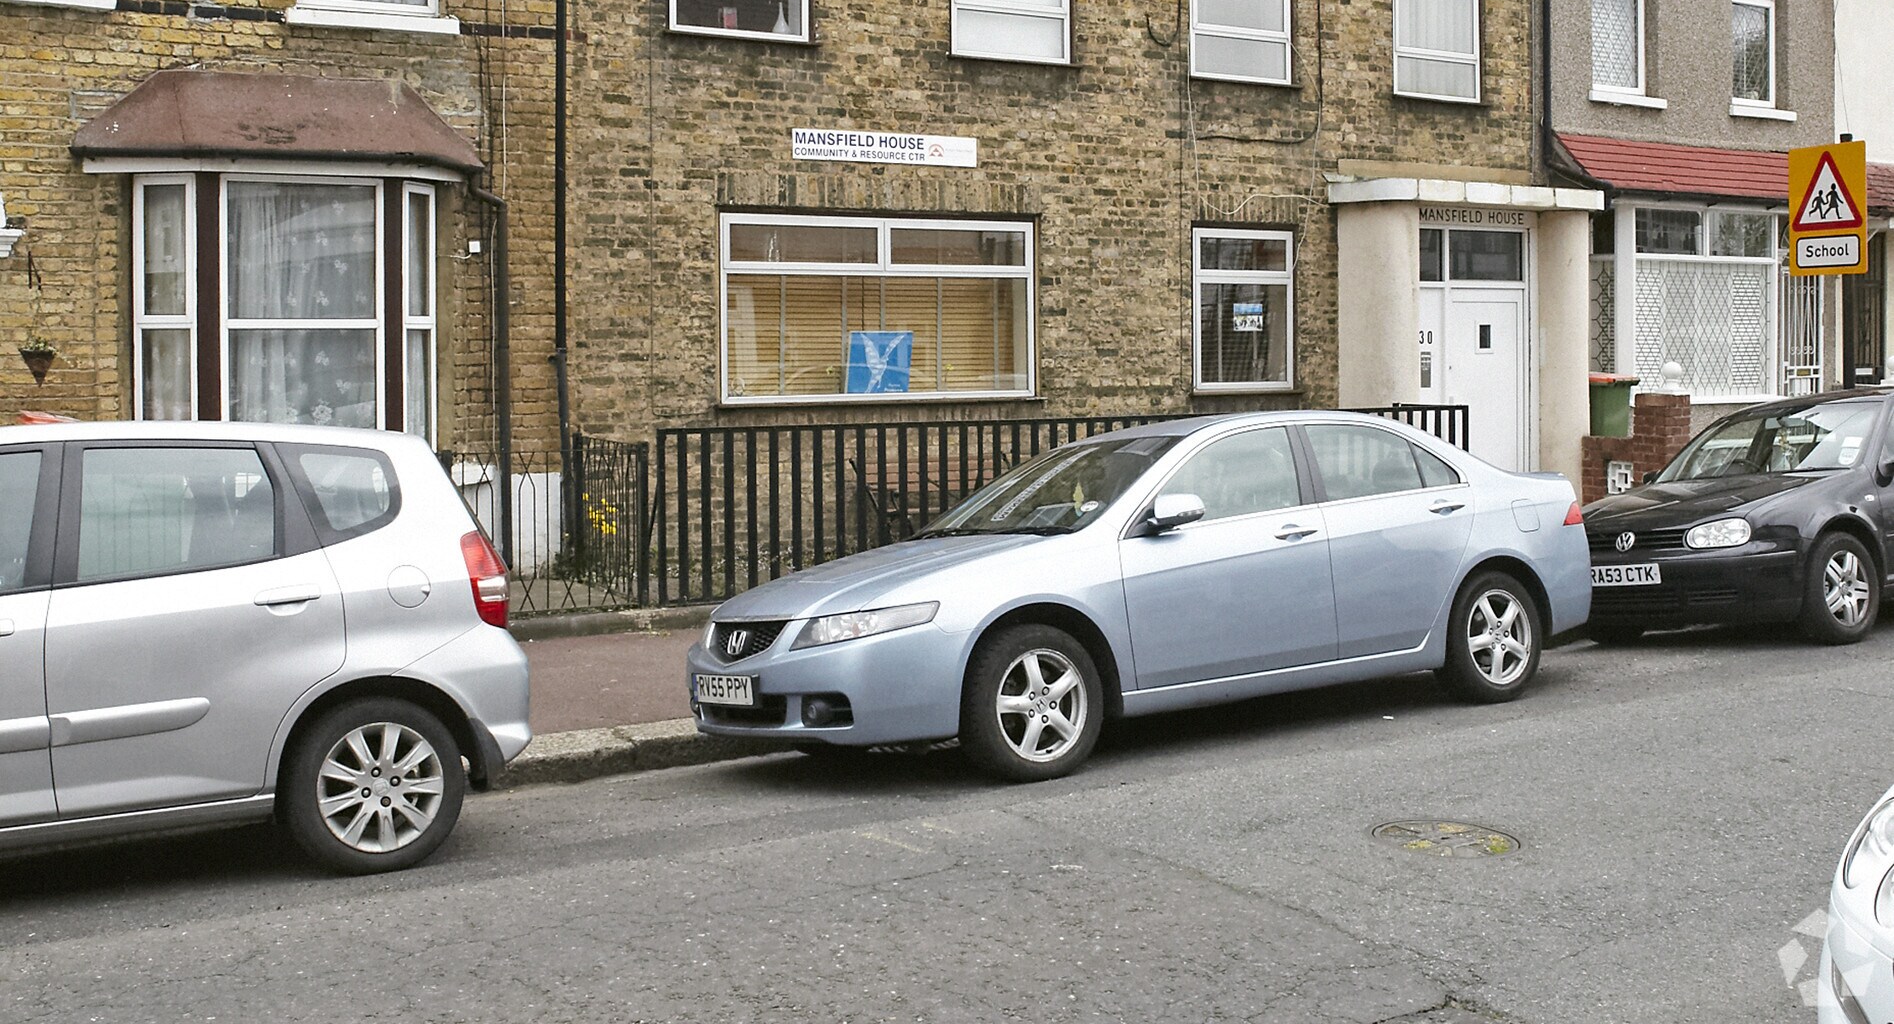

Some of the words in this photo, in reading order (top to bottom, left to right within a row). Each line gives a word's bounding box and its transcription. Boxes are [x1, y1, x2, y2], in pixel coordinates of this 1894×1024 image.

[795, 131, 875, 148] MANSFIELD
[879, 137, 925, 150] HOUSE
[794, 147, 849, 158] COMMUNITY
[852, 150, 858, 158] &
[860, 150, 906, 161] RESOURCE
[908, 152, 926, 162] CTR
[1419, 207, 1483, 223] MANSFIELD
[1488, 211, 1525, 225] HOUSE
[1805, 243, 1849, 258] School
[1418, 330, 1433, 345] 30
[1625, 566, 1655, 583] CTK
[698, 676, 725, 698] RV55
[726, 677, 748, 699] PPY
